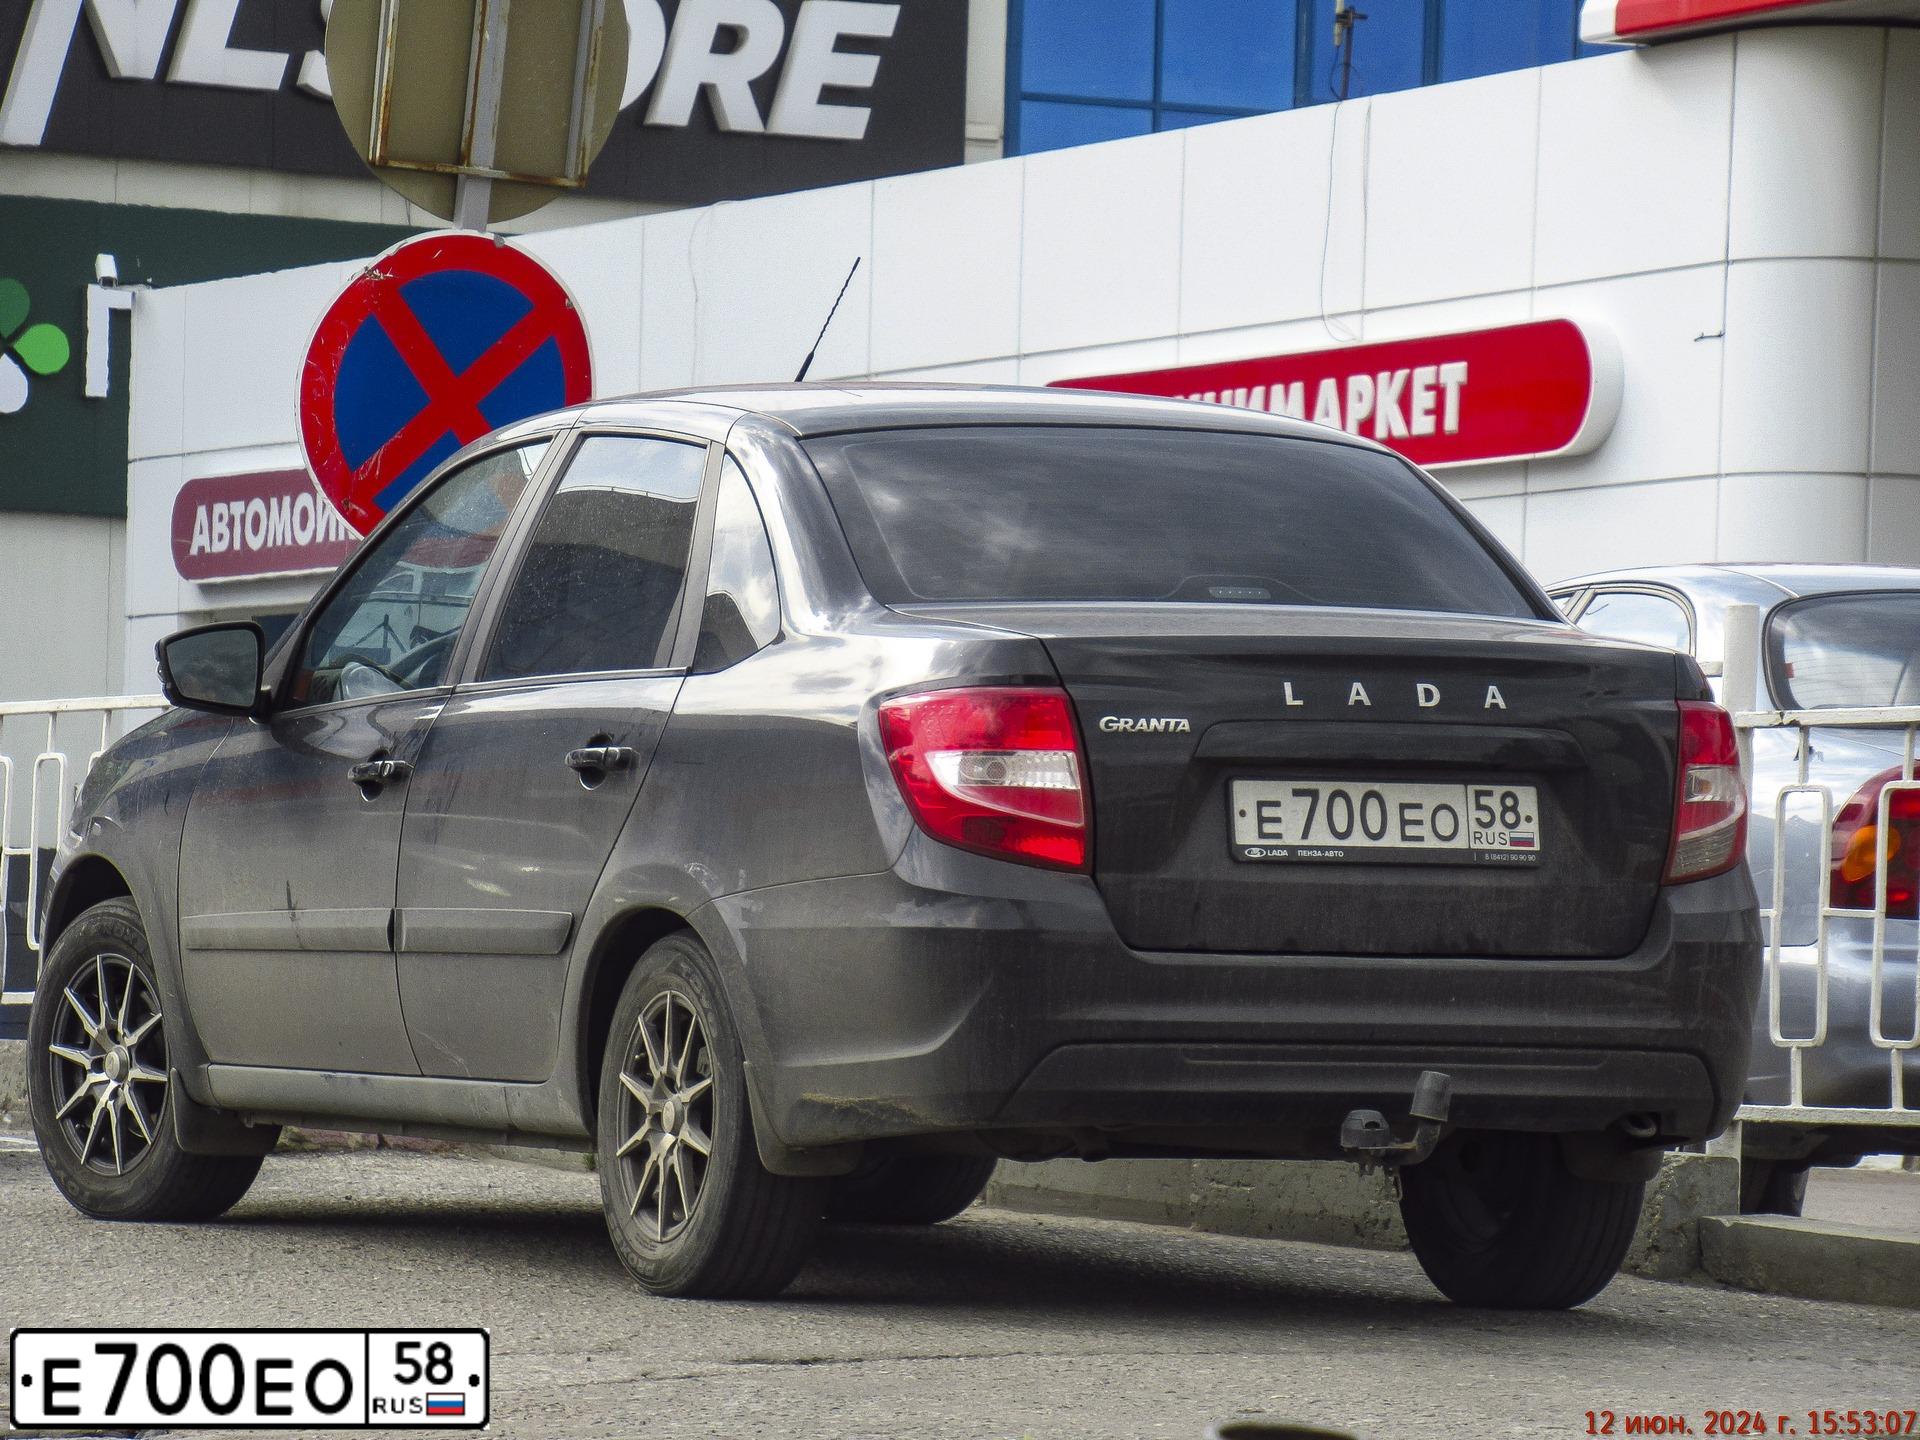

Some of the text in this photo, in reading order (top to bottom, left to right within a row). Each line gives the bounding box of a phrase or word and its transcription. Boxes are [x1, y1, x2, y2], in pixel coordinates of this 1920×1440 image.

[1283, 681, 1507, 710] LADA
[1099, 716, 1191, 733] GRANTA
[1474, 789, 1521, 829] 58
[1474, 831, 1508, 846] RUS
[1267, 849, 1289, 857] LADA
